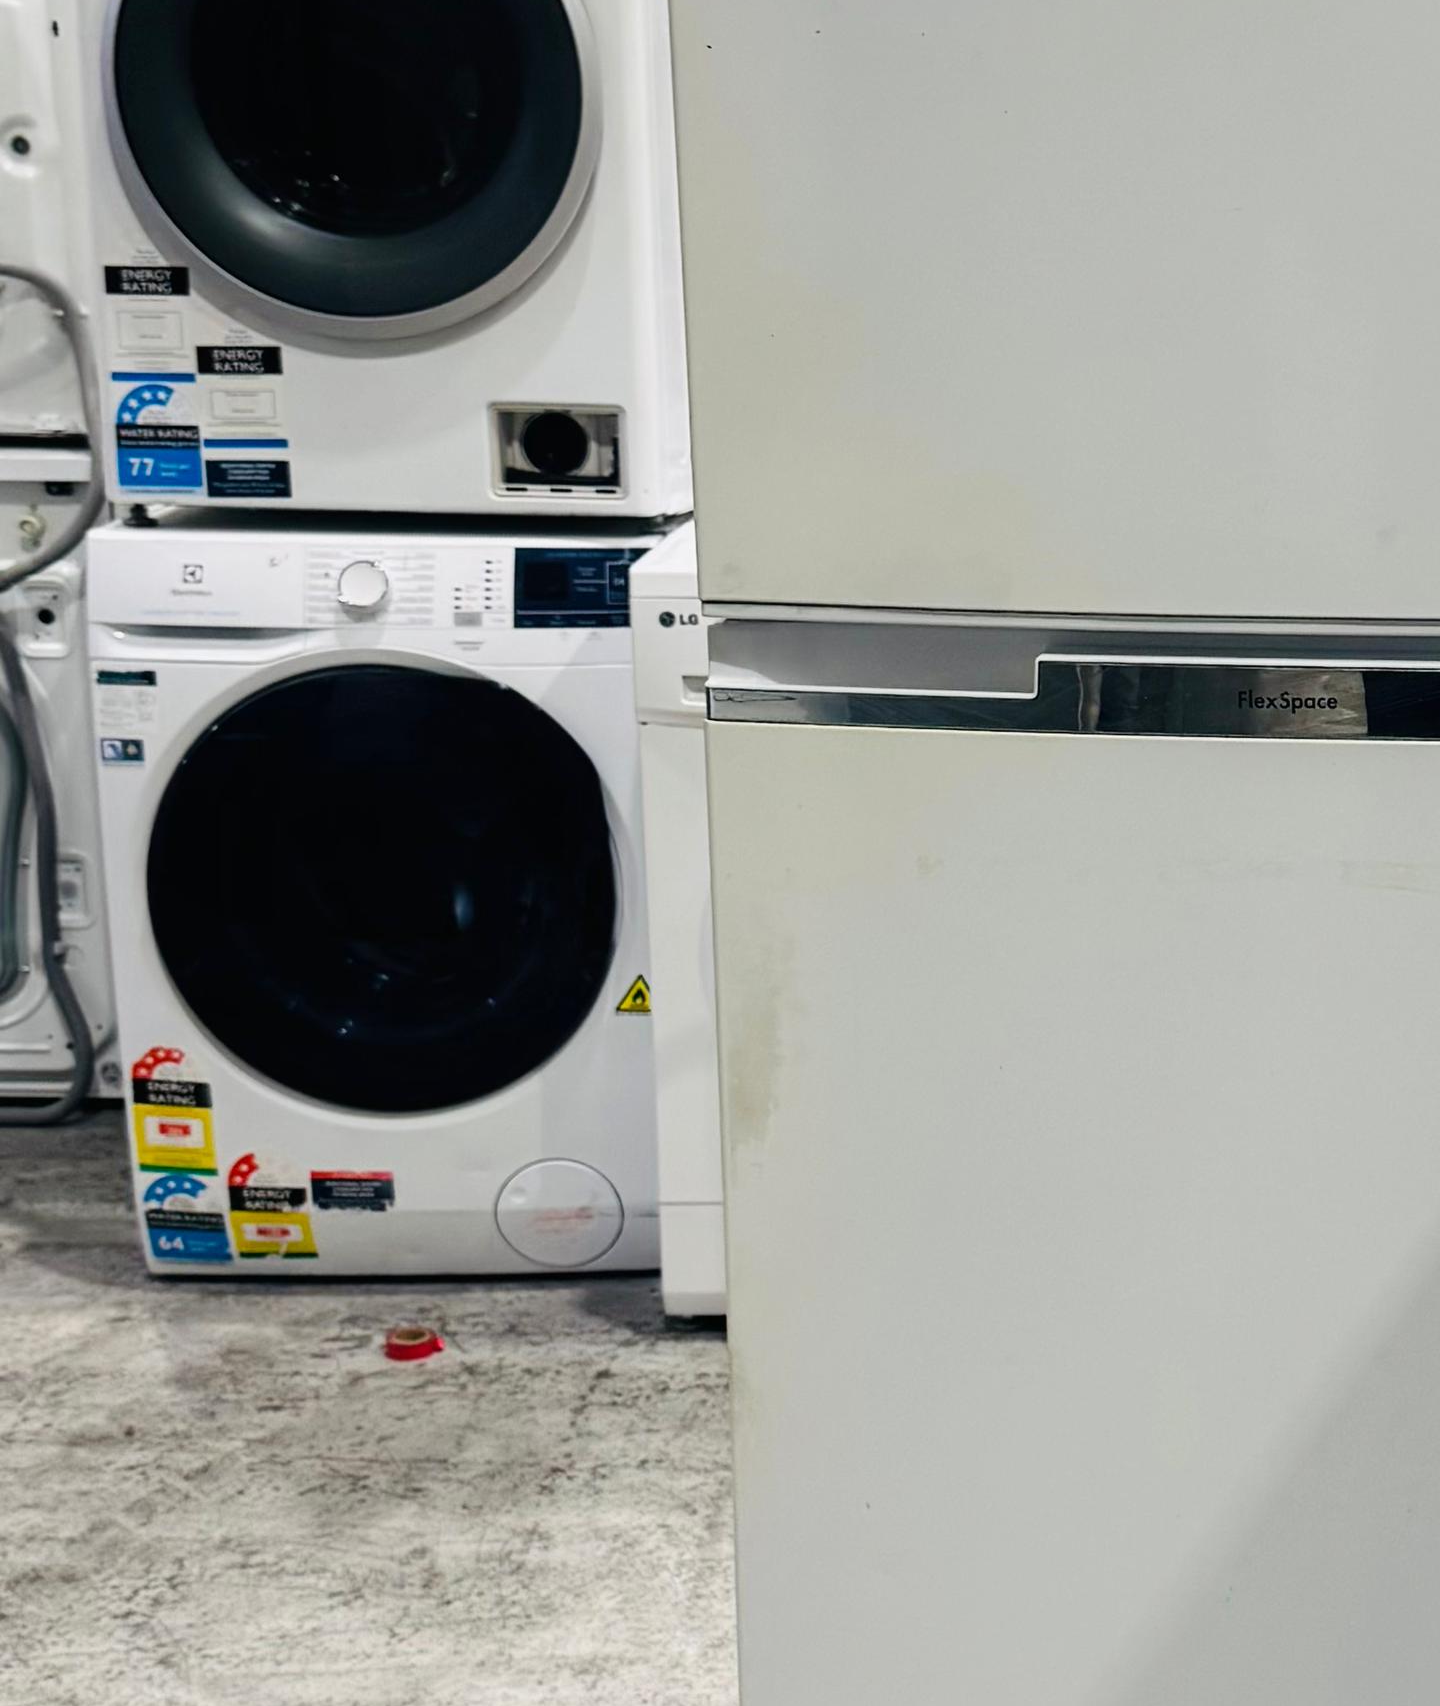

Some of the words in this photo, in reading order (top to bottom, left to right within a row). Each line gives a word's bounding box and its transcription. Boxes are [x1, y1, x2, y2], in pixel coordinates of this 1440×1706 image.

[120, 269, 172, 281] ENERGY
[121, 282, 173, 293] RATING
[212, 349, 264, 360] ENERGY
[214, 361, 265, 373] RATING
[128, 457, 155, 477] 77
[679, 613, 699, 626] LG
[1237, 689, 1338, 715] FlexSpace
[158, 1235, 185, 1251] 64
